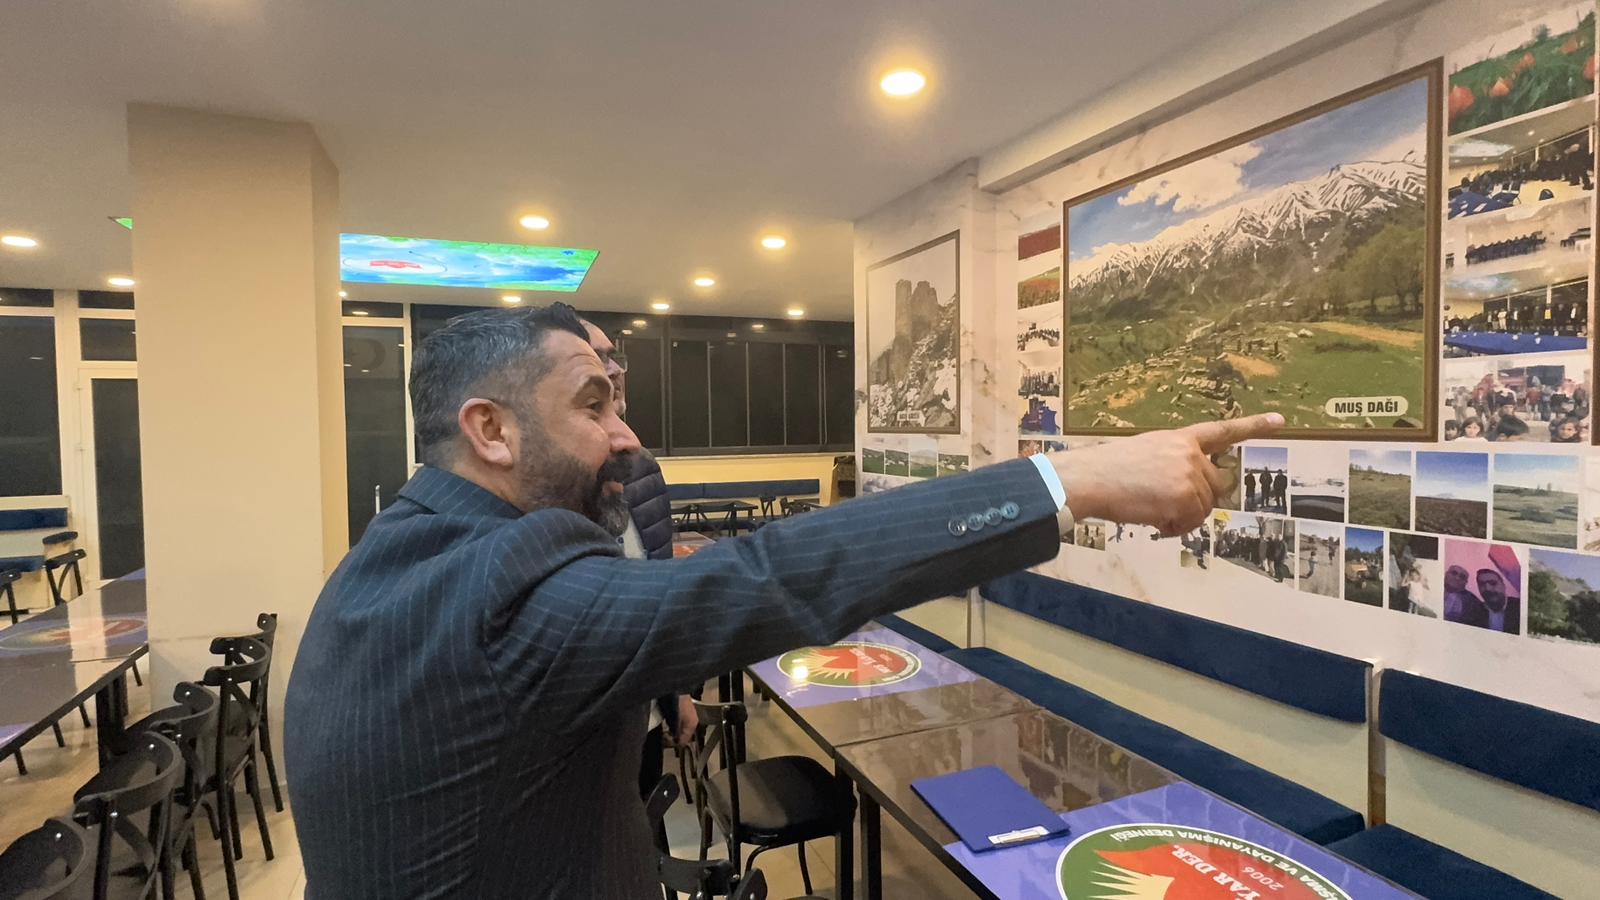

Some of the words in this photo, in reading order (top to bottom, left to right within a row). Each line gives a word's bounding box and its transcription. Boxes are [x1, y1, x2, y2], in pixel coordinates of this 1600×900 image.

[1335, 402, 1363, 416] MUŞ
[1367, 398, 1398, 413] DAĞI
[1110, 829, 1174, 842] DERNEĞİ
[1177, 831, 1275, 863] DAYANIŞMA
[1172, 844, 1217, 874] DER.
[1275, 861, 1298, 875] VE
[1241, 866, 1284, 891] 2006
